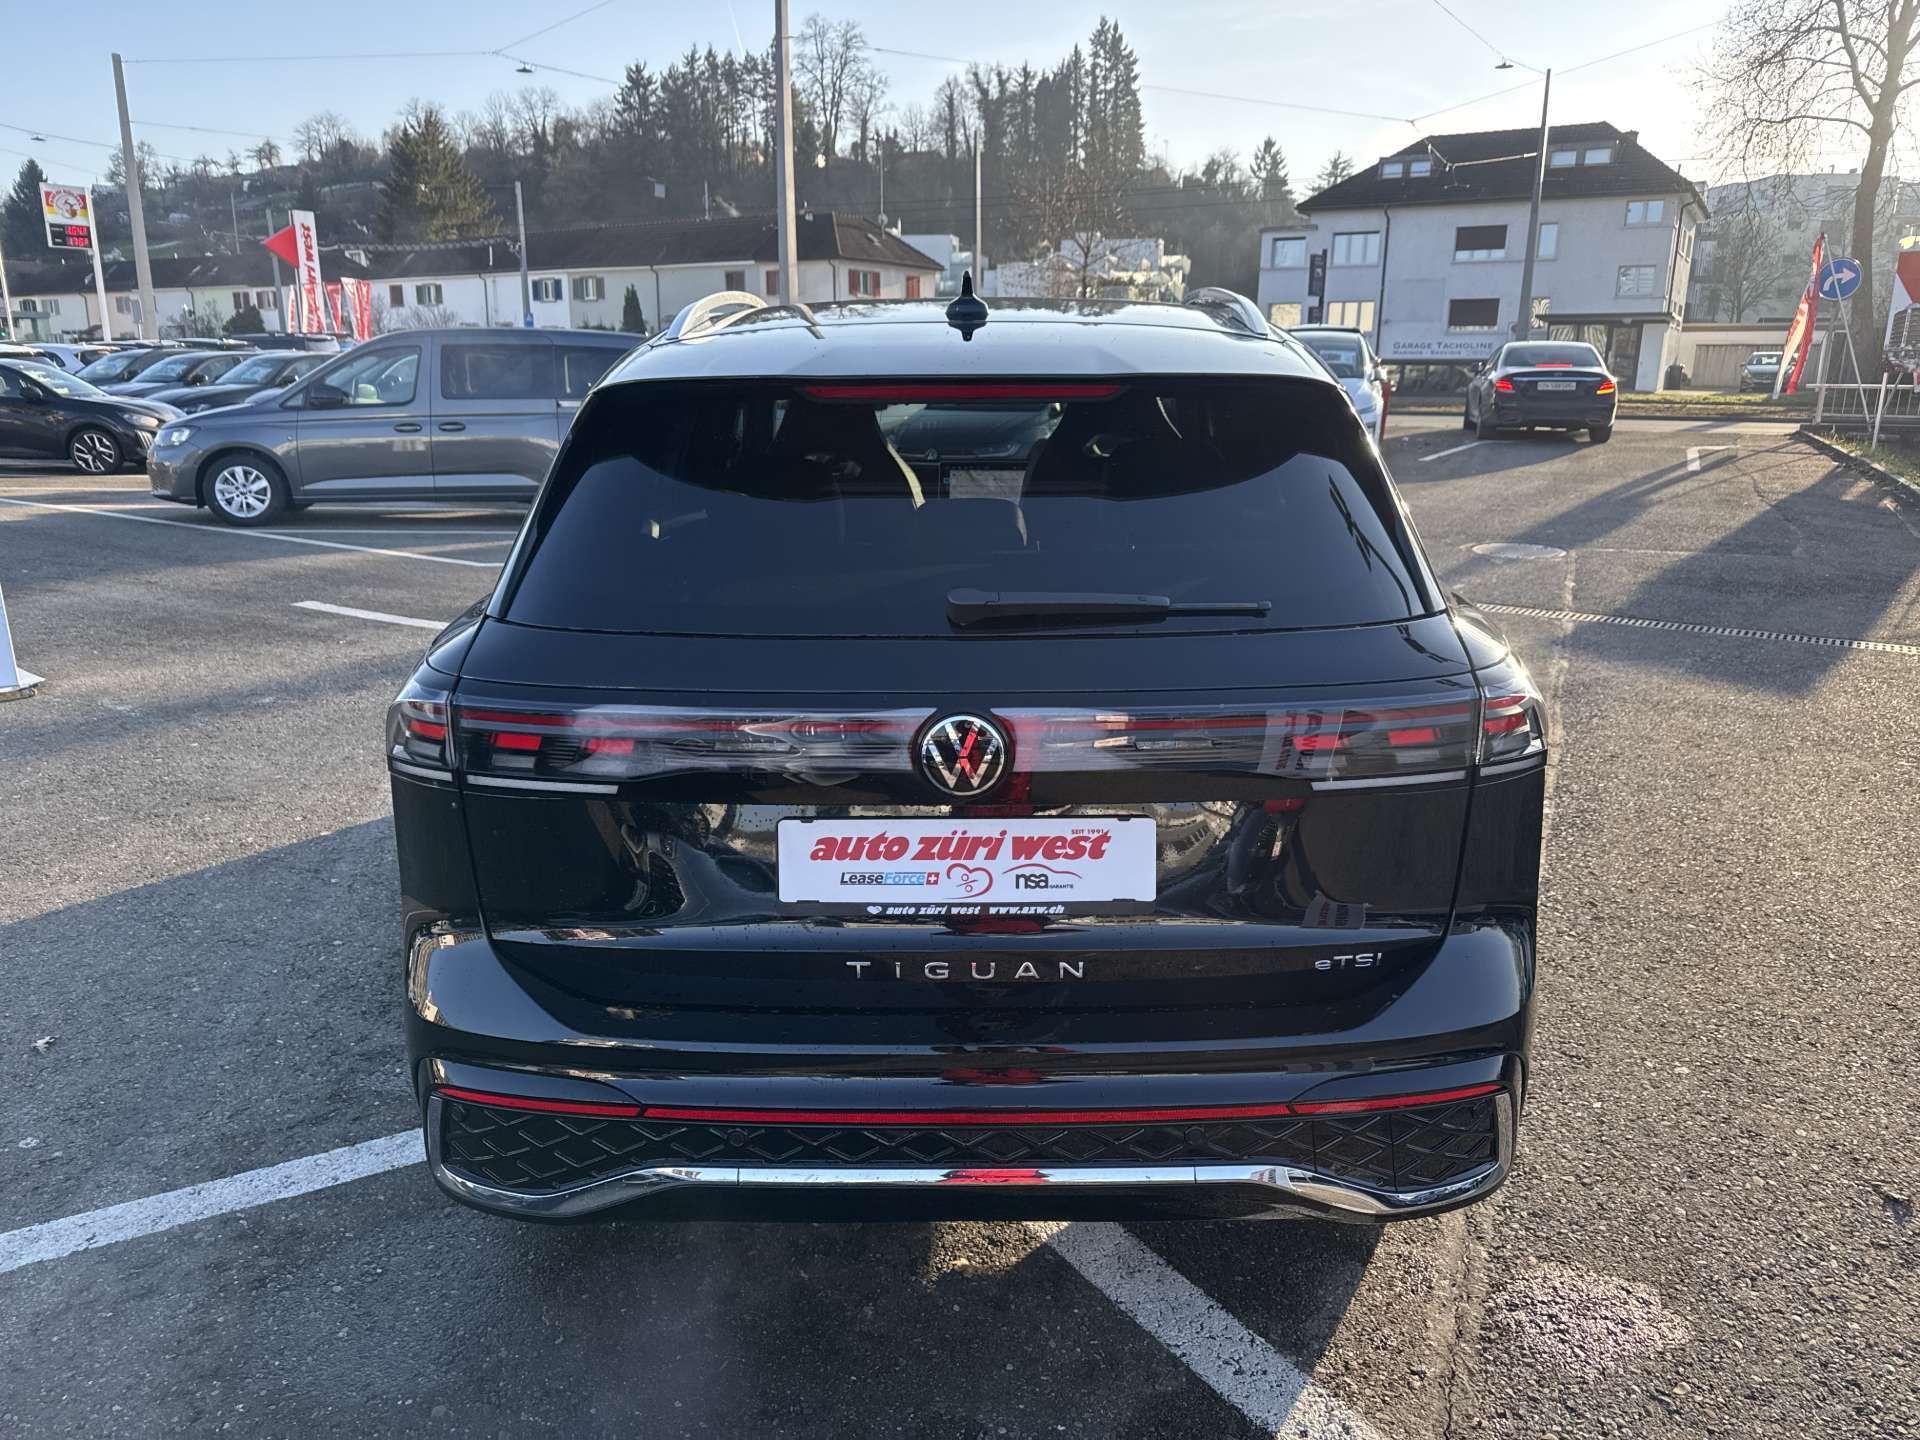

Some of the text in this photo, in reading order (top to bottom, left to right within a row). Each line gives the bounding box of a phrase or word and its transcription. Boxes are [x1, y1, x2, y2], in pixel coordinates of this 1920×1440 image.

[1393, 342, 1494, 350] GARAGE TACHOLINE
[810, 829, 1112, 861] auto züri west
[840, 871, 926, 886] LeaseForce
[1015, 873, 1049, 890] nsa
[885, 905, 916, 915] auto
[918, 904, 947, 915] züri
[950, 905, 981, 915] west
[1314, 952, 1383, 970] eTSI
